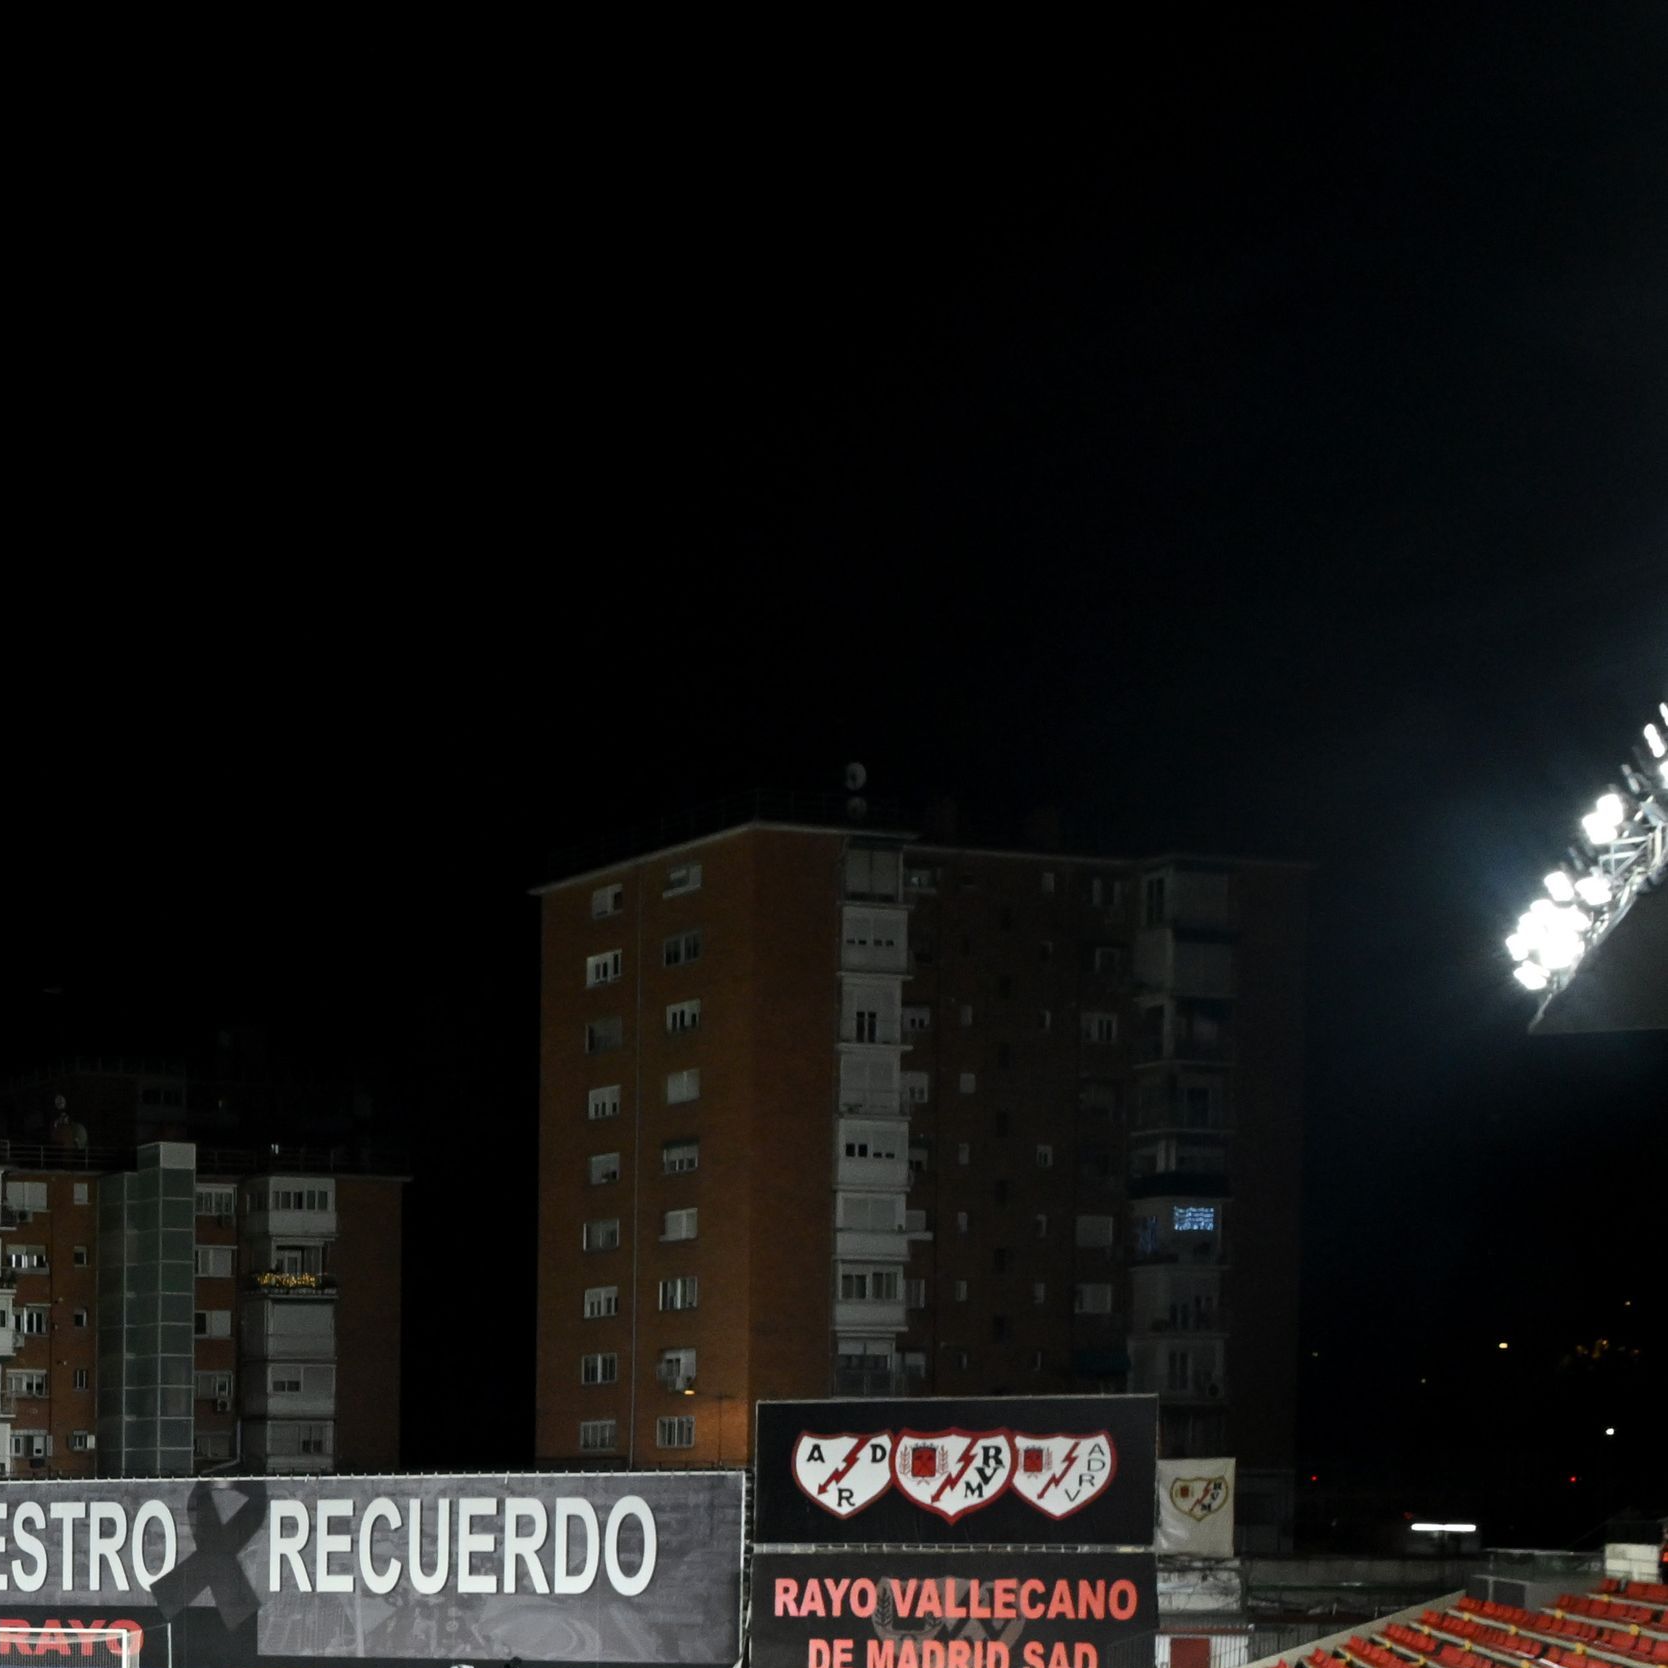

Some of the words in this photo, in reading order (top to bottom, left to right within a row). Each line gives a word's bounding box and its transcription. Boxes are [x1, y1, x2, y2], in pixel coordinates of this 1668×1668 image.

[806, 1444, 826, 1464] A
[870, 1443, 887, 1463] D
[837, 1488, 856, 1507] R
[268, 1495, 659, 1598] RECUERDO
[774, 1578, 877, 1618] RAYO
[891, 1579, 1138, 1620] VALLECANO
